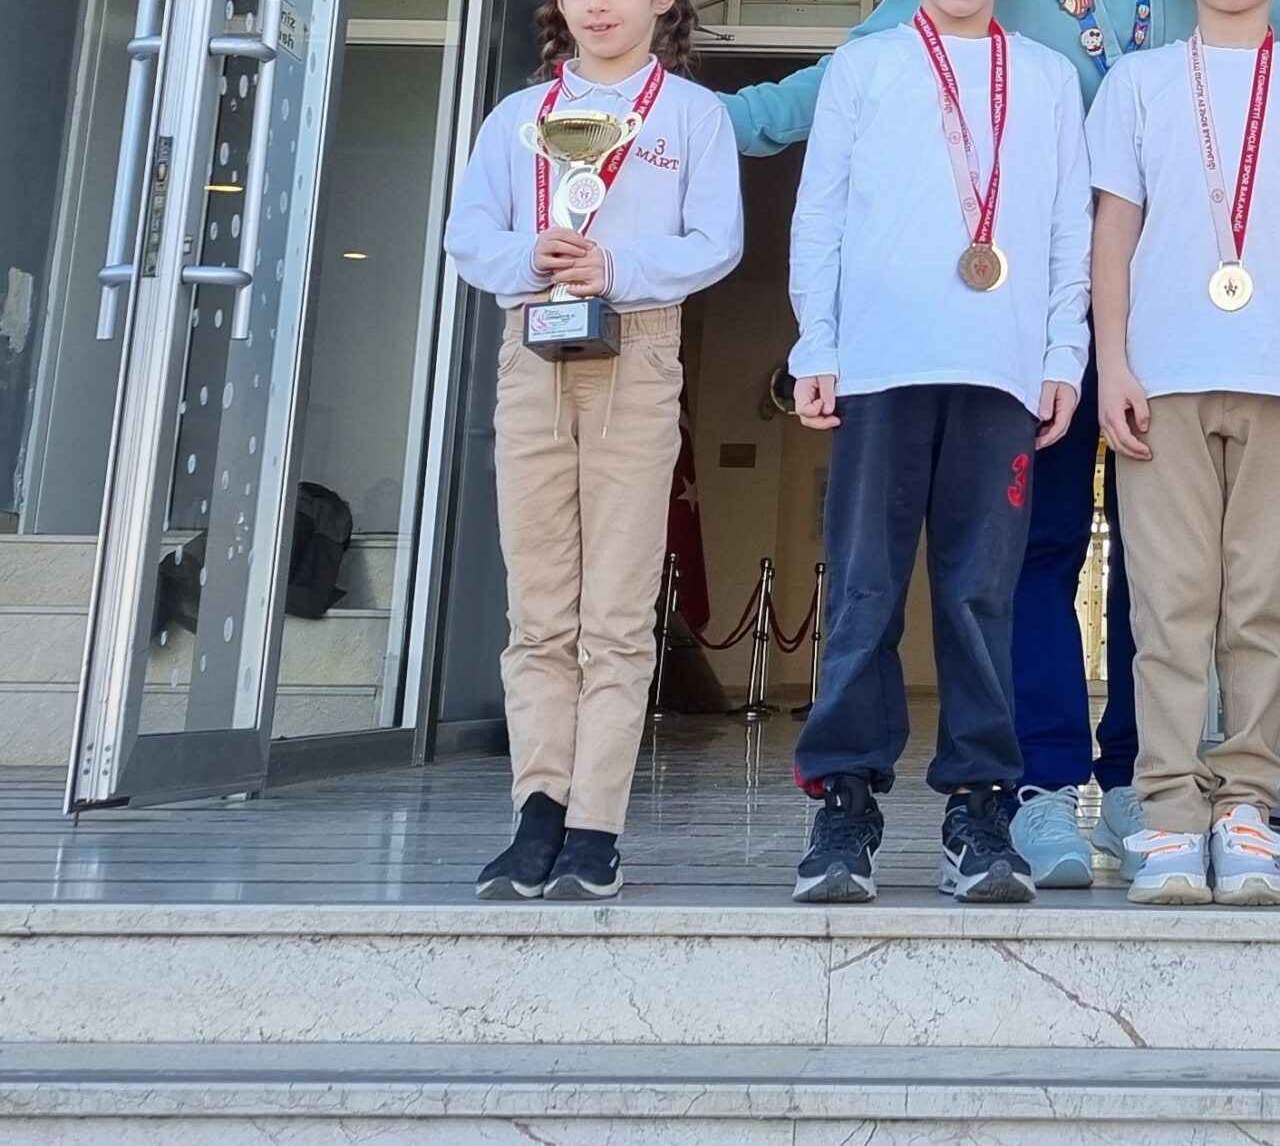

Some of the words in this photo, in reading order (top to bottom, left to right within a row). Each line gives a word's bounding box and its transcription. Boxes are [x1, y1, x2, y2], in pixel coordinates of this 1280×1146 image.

[654, 138, 666, 156] 3
[635, 146, 680, 171] MART
[1241, 164, 1251, 185] SPOR
